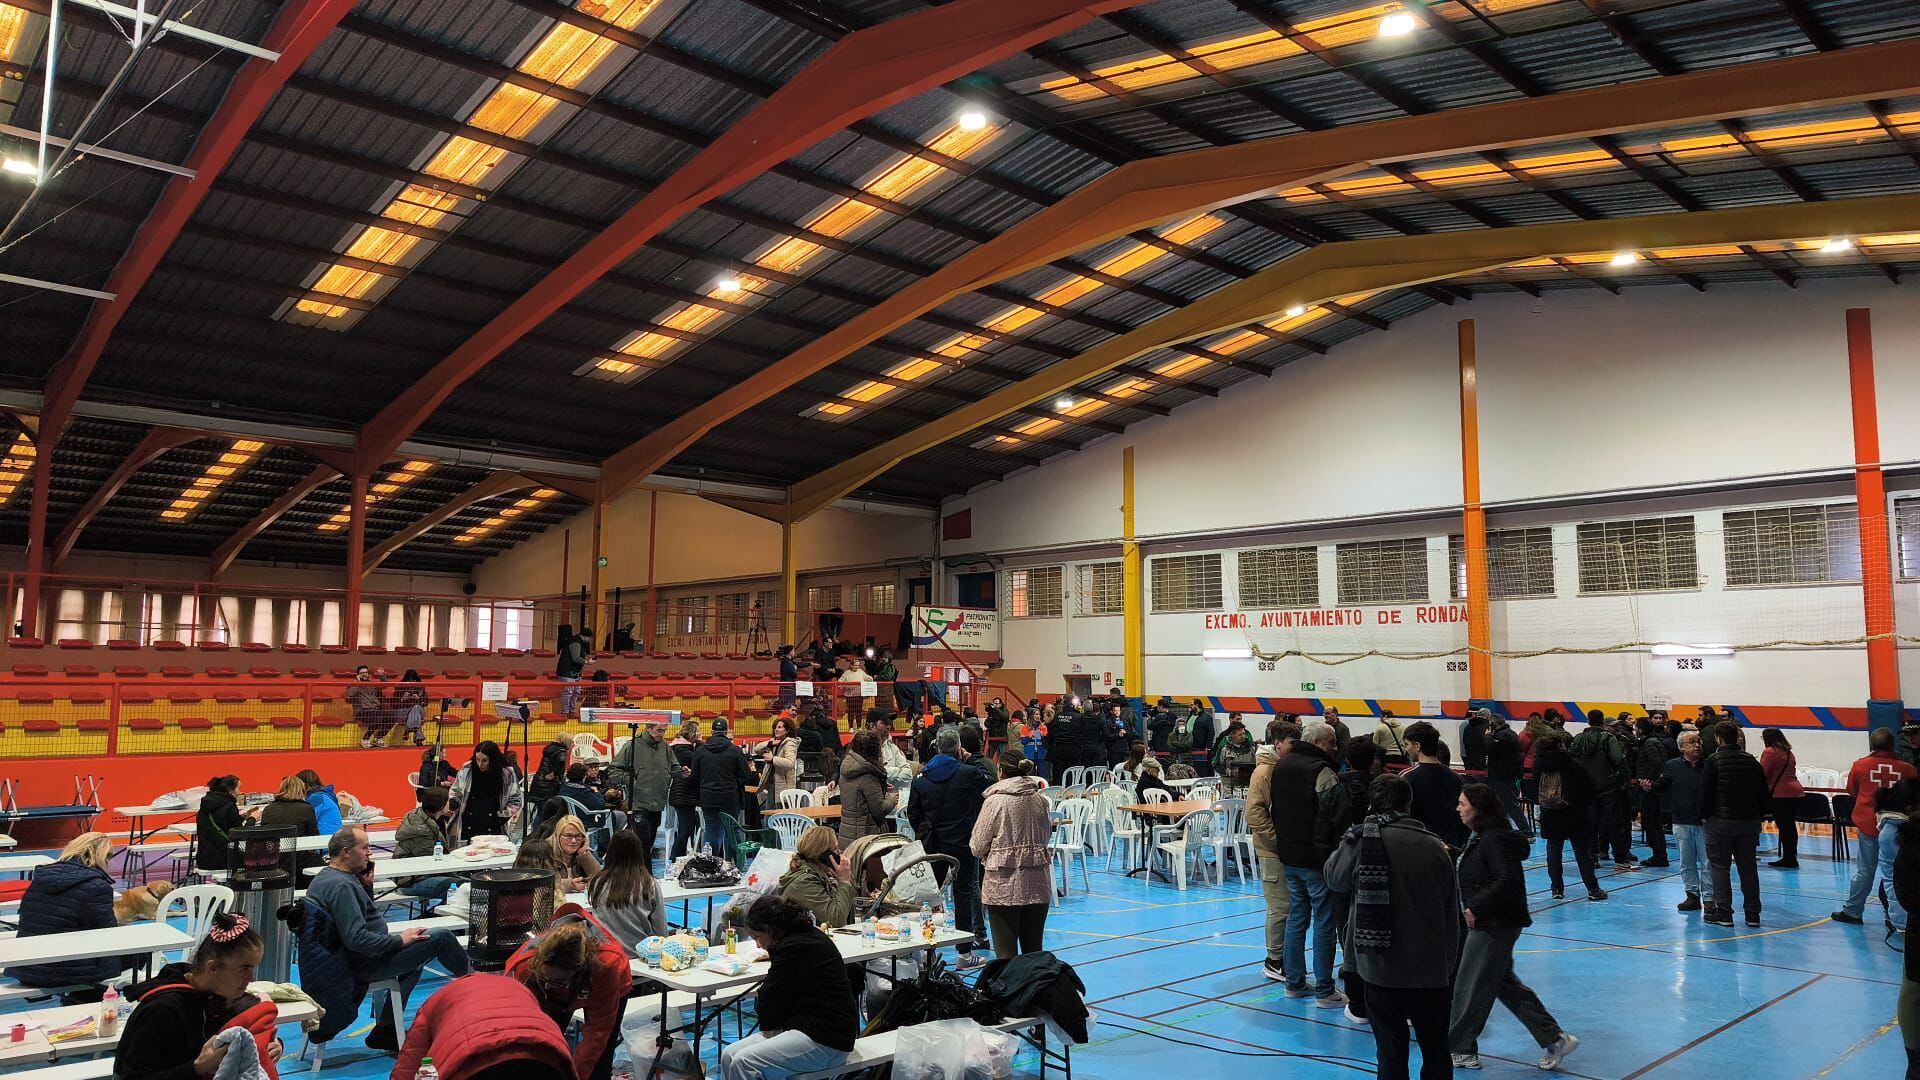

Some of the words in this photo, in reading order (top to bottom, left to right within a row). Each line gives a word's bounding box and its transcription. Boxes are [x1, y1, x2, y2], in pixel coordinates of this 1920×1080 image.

[1205, 613, 1251, 629] EXCMO.
[1261, 610, 1362, 627] AYUNTAMIENTO
[1378, 610, 1402, 624] DE
[1417, 606, 1468, 623] RONDA
